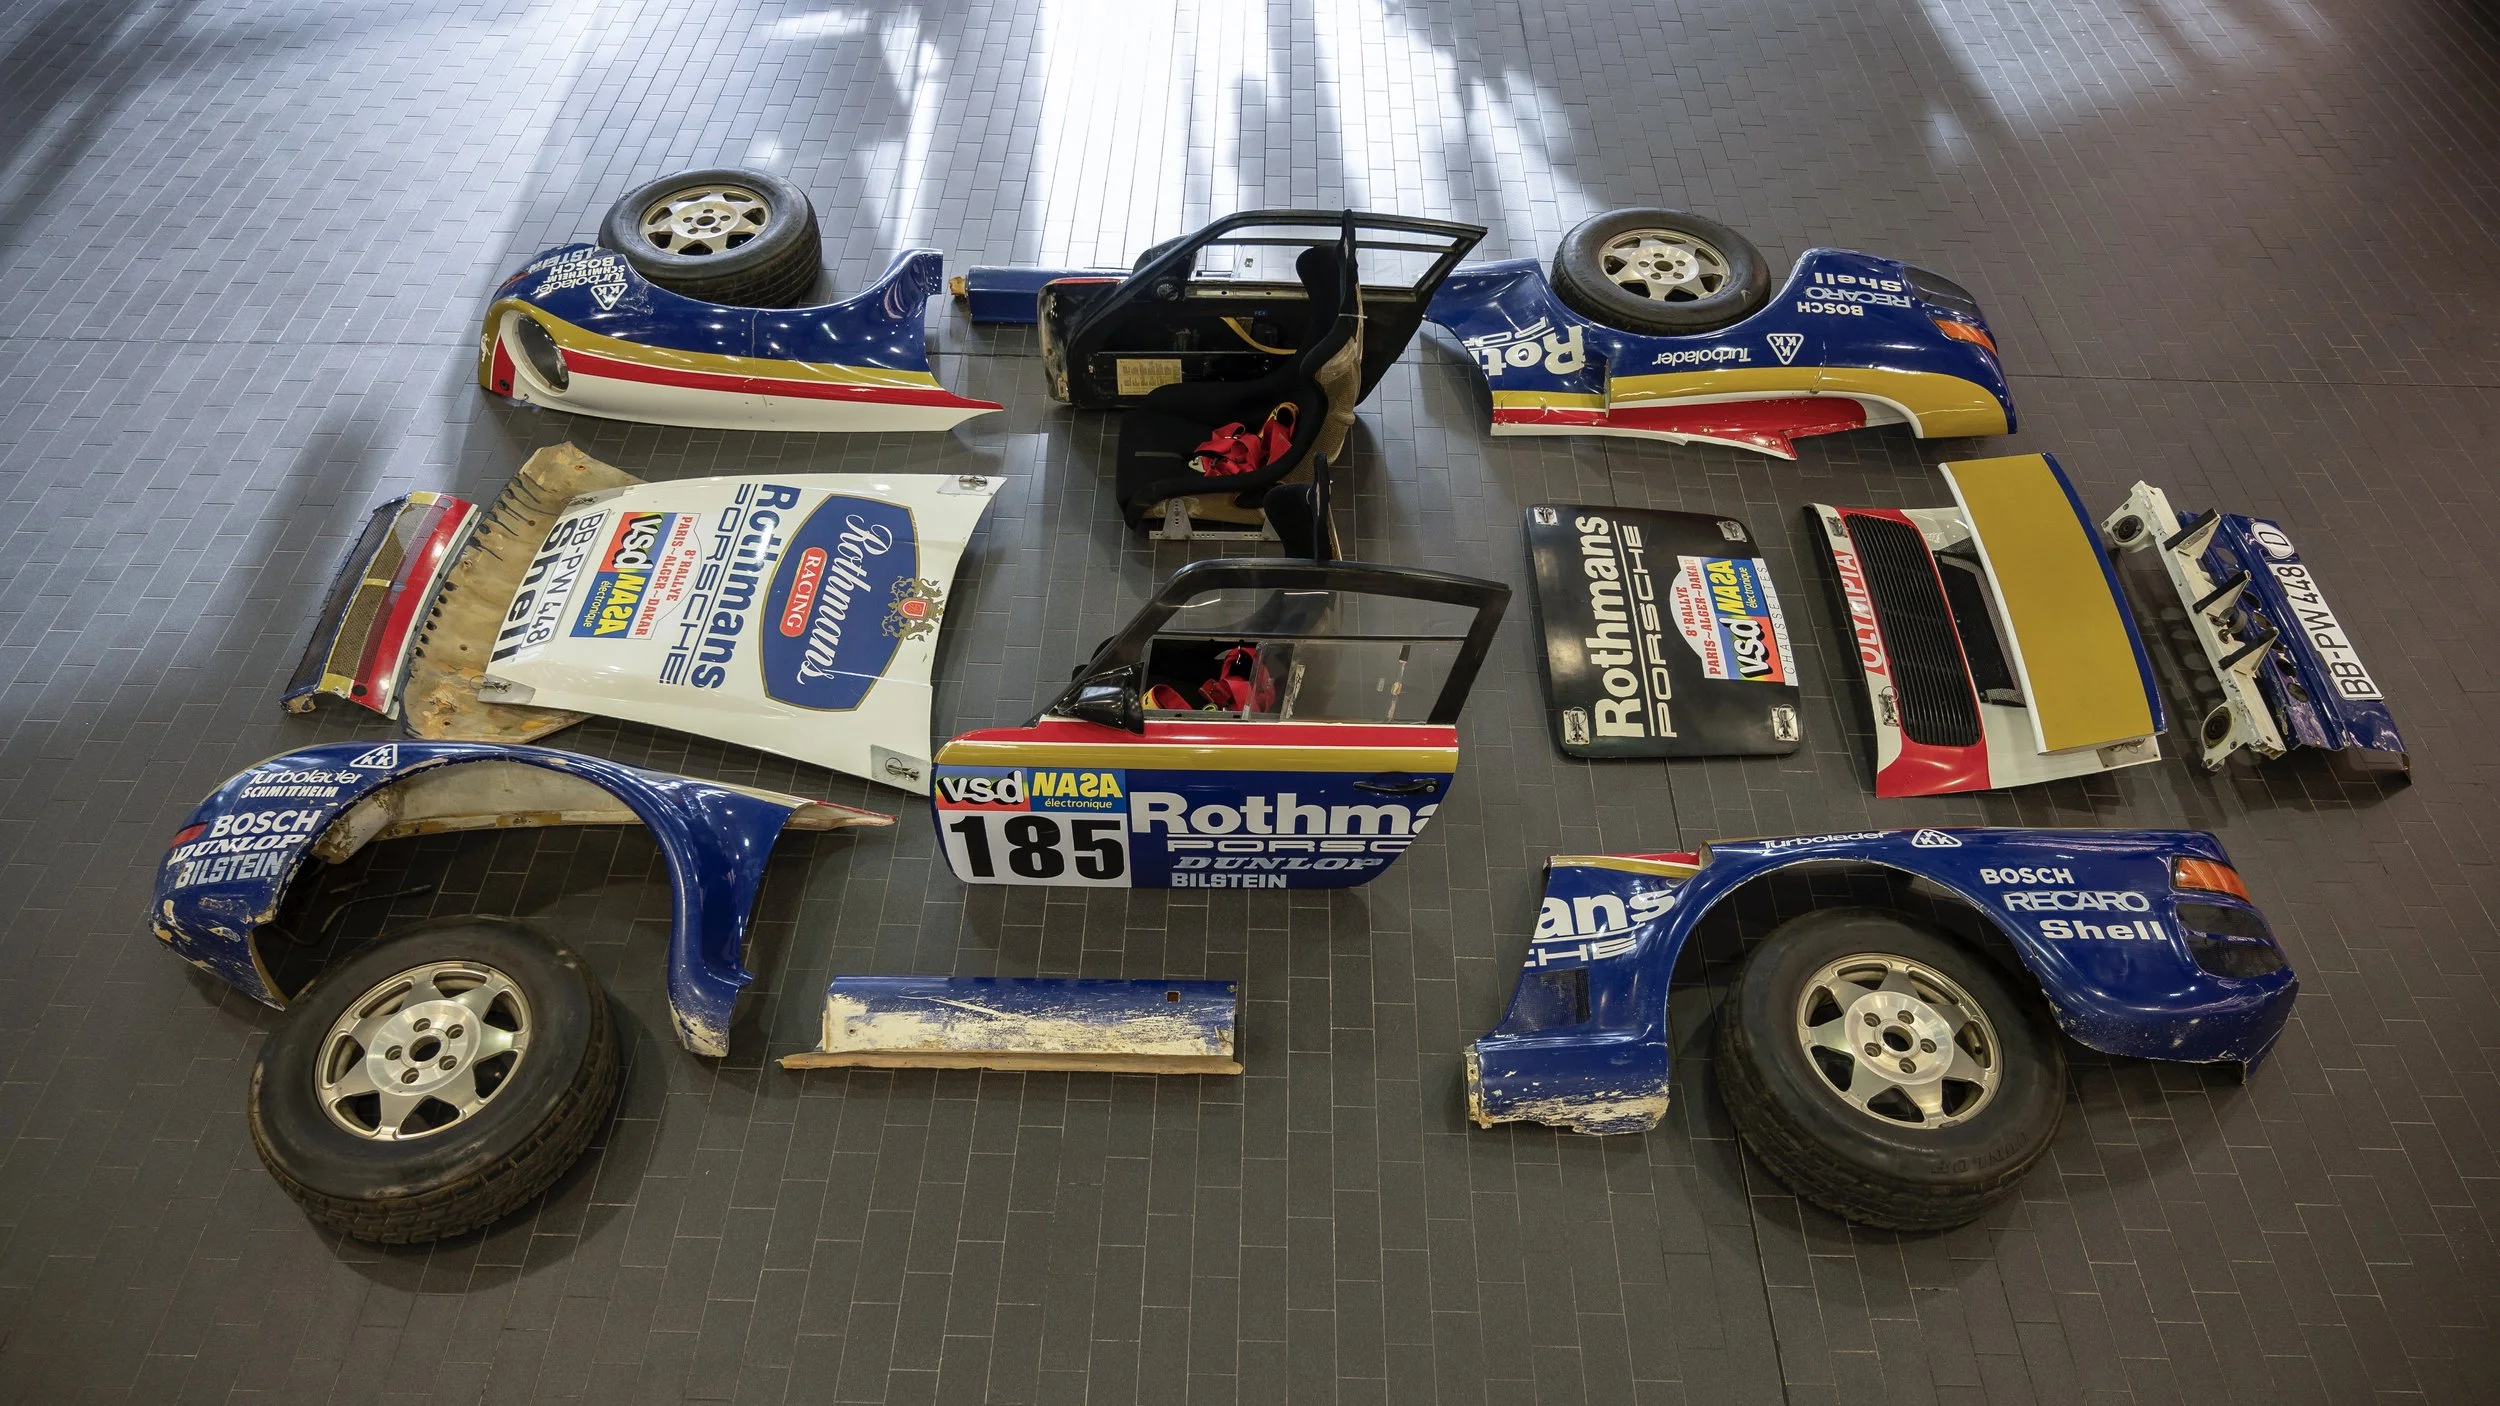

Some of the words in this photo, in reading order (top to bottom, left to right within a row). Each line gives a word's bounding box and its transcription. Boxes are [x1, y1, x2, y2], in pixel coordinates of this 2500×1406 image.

[550, 257, 615, 275] BOSCH
[1814, 272, 1902, 292] Shell
[531, 274, 626, 295] Turbolader
[1805, 287, 1912, 308] RECARO
[1797, 302, 1863, 316] BOSCH
[1652, 347, 1751, 367] Turbolader
[613, 515, 662, 569] vsd
[2258, 530, 2289, 547] D
[490, 517, 578, 663] Shell
[659, 484, 751, 685] PORSCHE
[666, 560, 692, 601] RALLYE
[691, 484, 802, 689] Rothmans
[786, 554, 821, 629] RACING
[1739, 567, 1757, 609] électronique
[2277, 566, 2319, 606] 448
[583, 580, 609, 628] électronique
[797, 514, 893, 685] Rothmans
[1676, 587, 1695, 625] RALLYE
[1835, 555, 1882, 668] OLYMPIA
[526, 602, 562, 644] 448
[1575, 516, 1645, 737] Rothmans
[1622, 525, 1677, 738] PORSCHE
[1757, 567, 1795, 675] CHAUSSETTES
[1719, 618, 1769, 676] vsd
[241, 786, 340, 799] SCHMITTHELM
[250, 769, 364, 784] Turbolader
[942, 770, 1025, 804] vsd
[1045, 798, 1113, 810] électronique
[210, 810, 322, 838] BOSCH
[1759, 831, 1889, 849] Turbolader
[167, 834, 306, 868] DUNLOP
[950, 815, 1124, 880] 185
[1173, 856, 1384, 870] DUNLOP
[175, 851, 288, 889] BILSTEIN
[1171, 873, 1287, 888] BILSTEIN
[1980, 868, 2075, 884] BOSCH
[2003, 891, 2150, 912] RECARO
[2039, 920, 2168, 941] Shell
